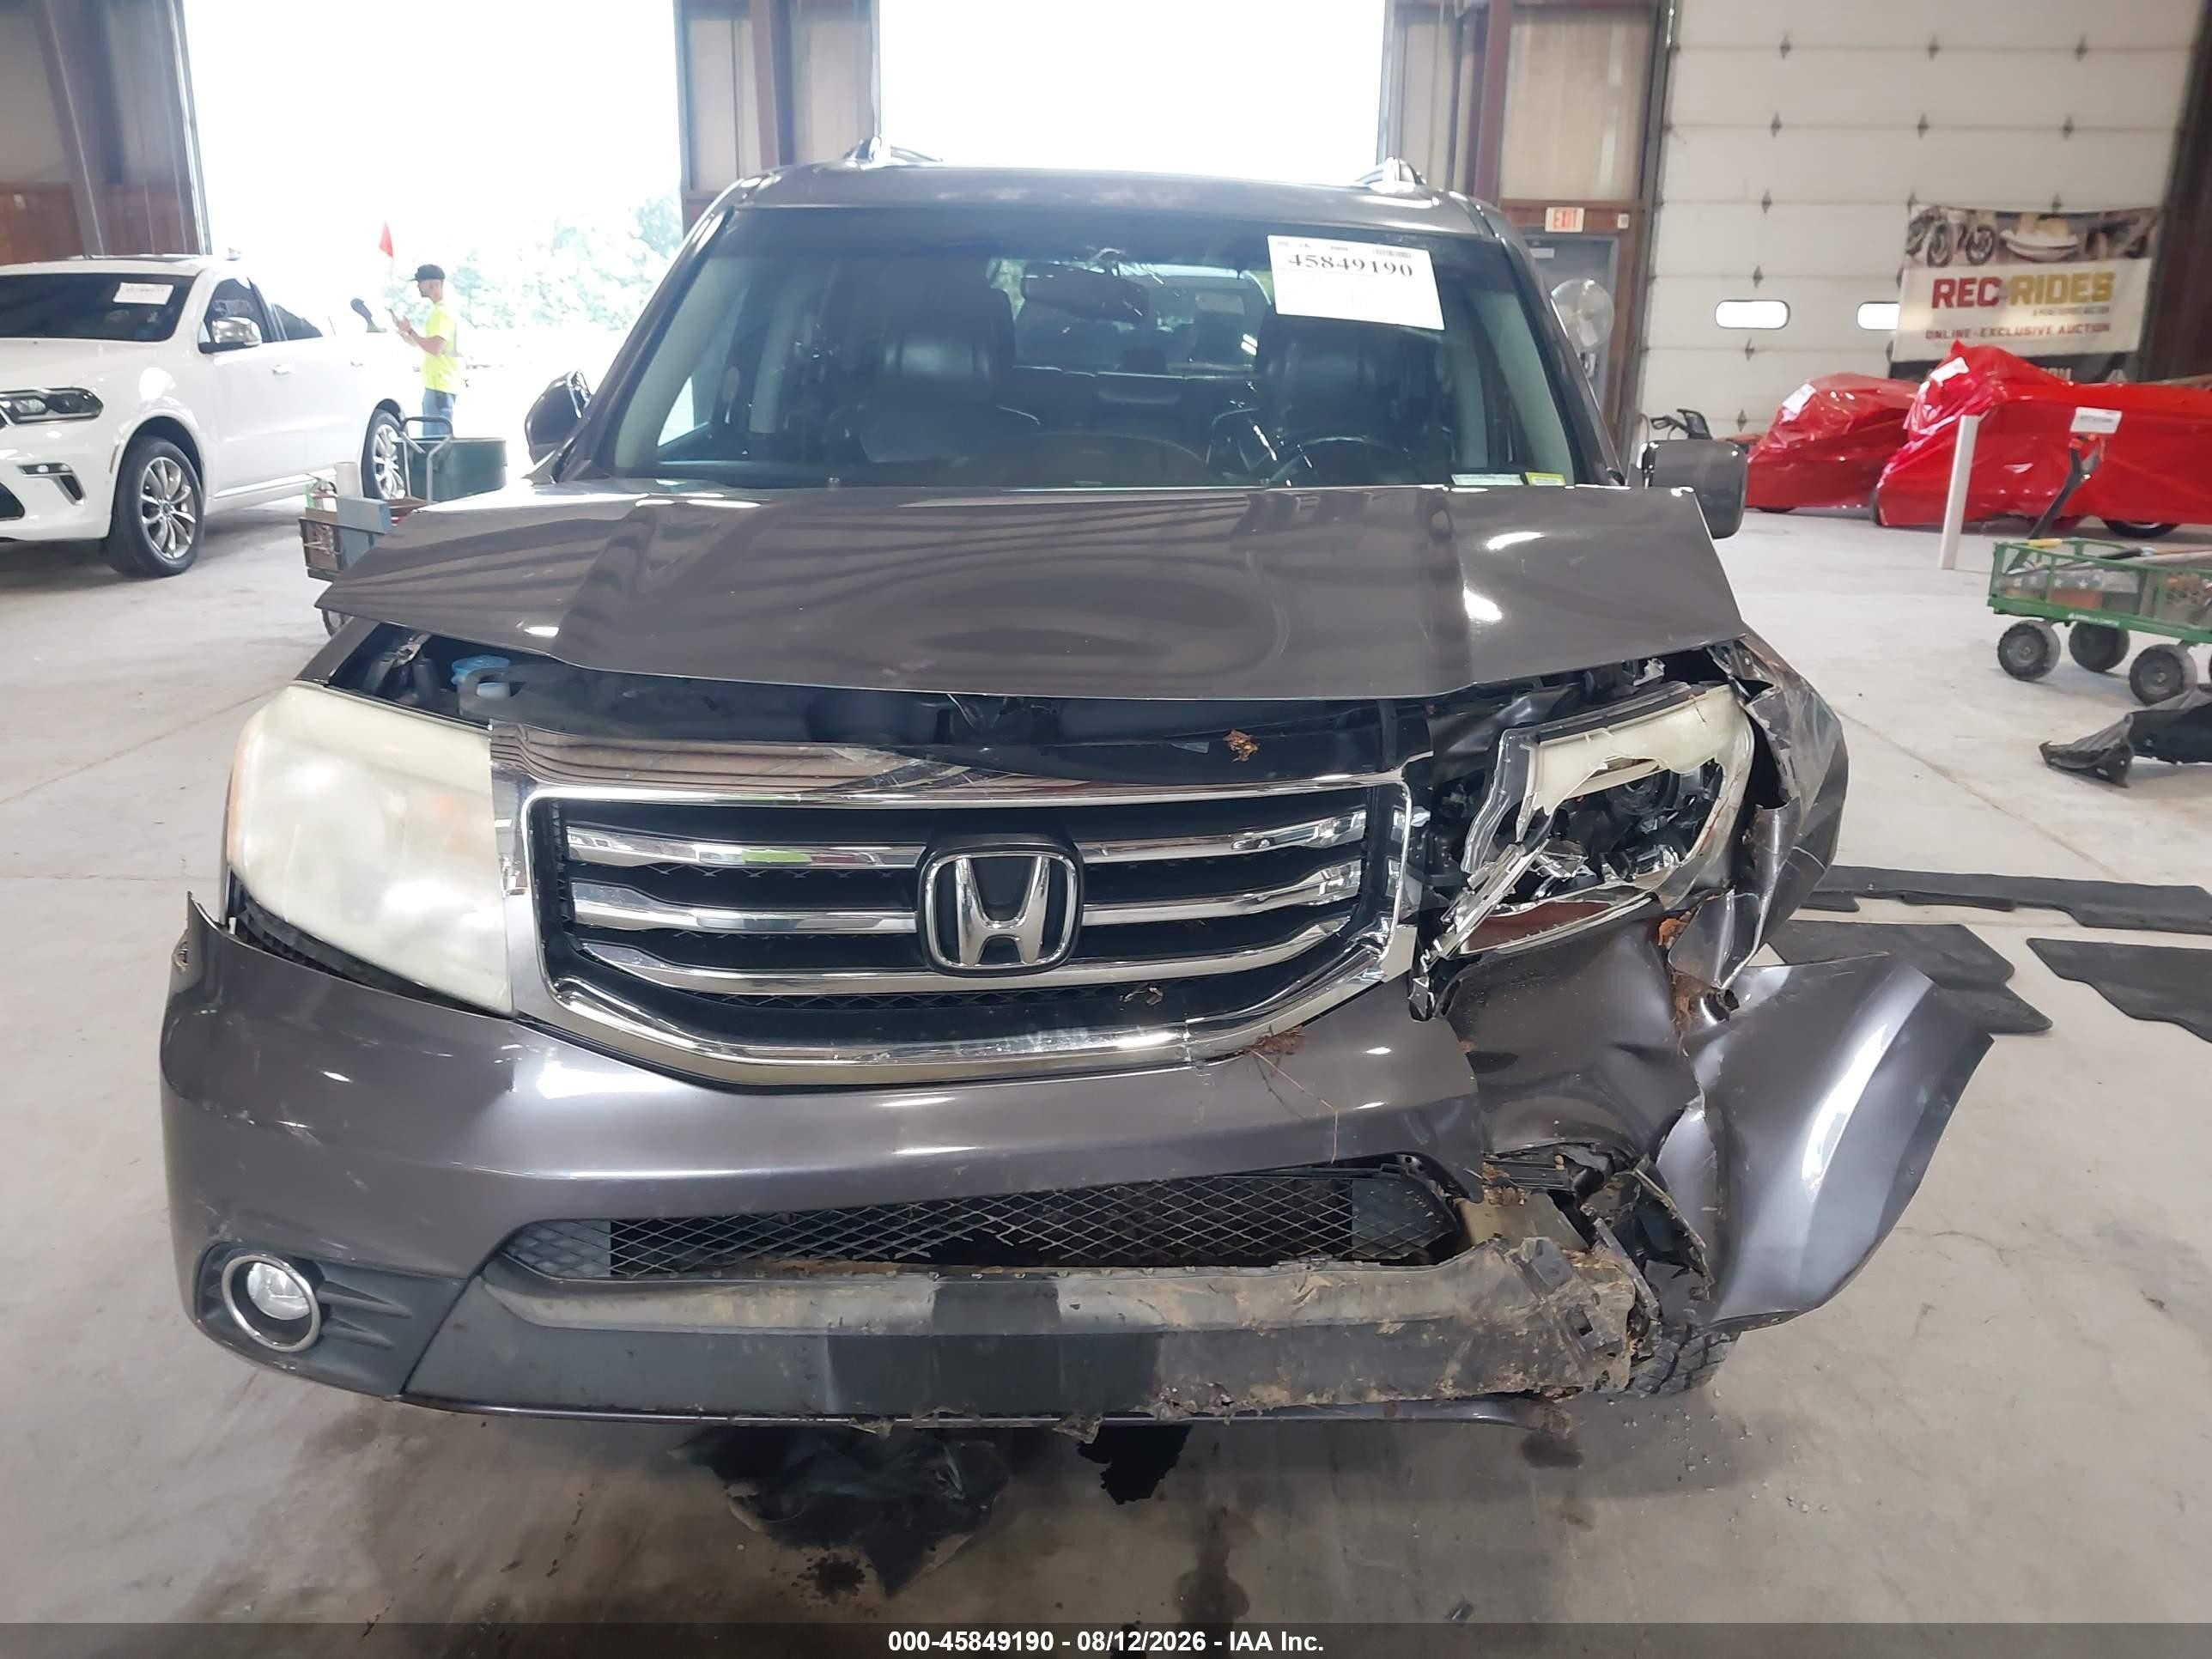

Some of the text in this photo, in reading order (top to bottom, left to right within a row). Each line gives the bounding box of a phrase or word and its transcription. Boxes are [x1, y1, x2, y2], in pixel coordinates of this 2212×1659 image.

[1289, 254, 1413, 276] 45849190
[1932, 271, 2115, 309] REC RIDES
